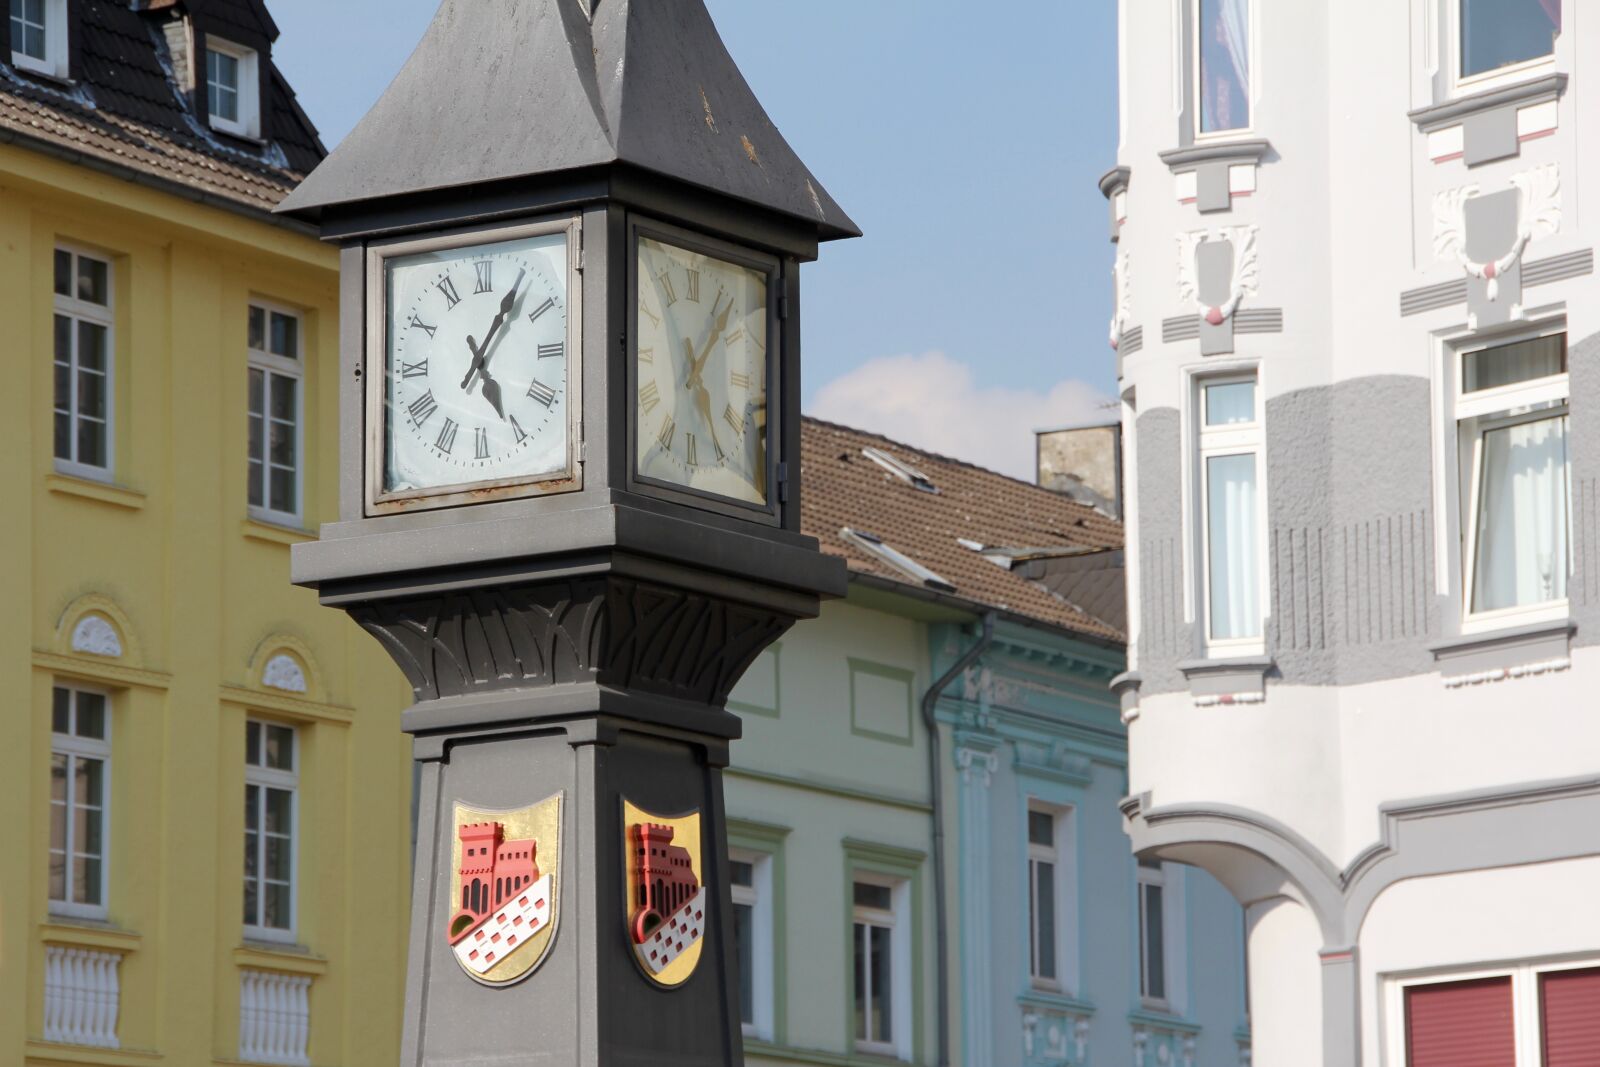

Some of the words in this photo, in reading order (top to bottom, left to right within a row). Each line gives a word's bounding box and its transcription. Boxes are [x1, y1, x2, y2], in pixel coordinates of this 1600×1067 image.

[436, 275, 462, 311] XI
[473, 260, 494, 295] XII
[659, 271, 678, 308] XI
[686, 268, 701, 304] XII
[410, 313, 438, 340] X
[528, 296, 555, 324] II
[537, 340, 564, 360] III
[402, 356, 429, 380] IX
[730, 369, 749, 389] III
[407, 386, 438, 430] VIII
[526, 376, 556, 410] IIII
[433, 416, 459, 454] VII
[473, 427, 491, 460] VI
[509, 413, 528, 444] V
[686, 432, 698, 467] VI
